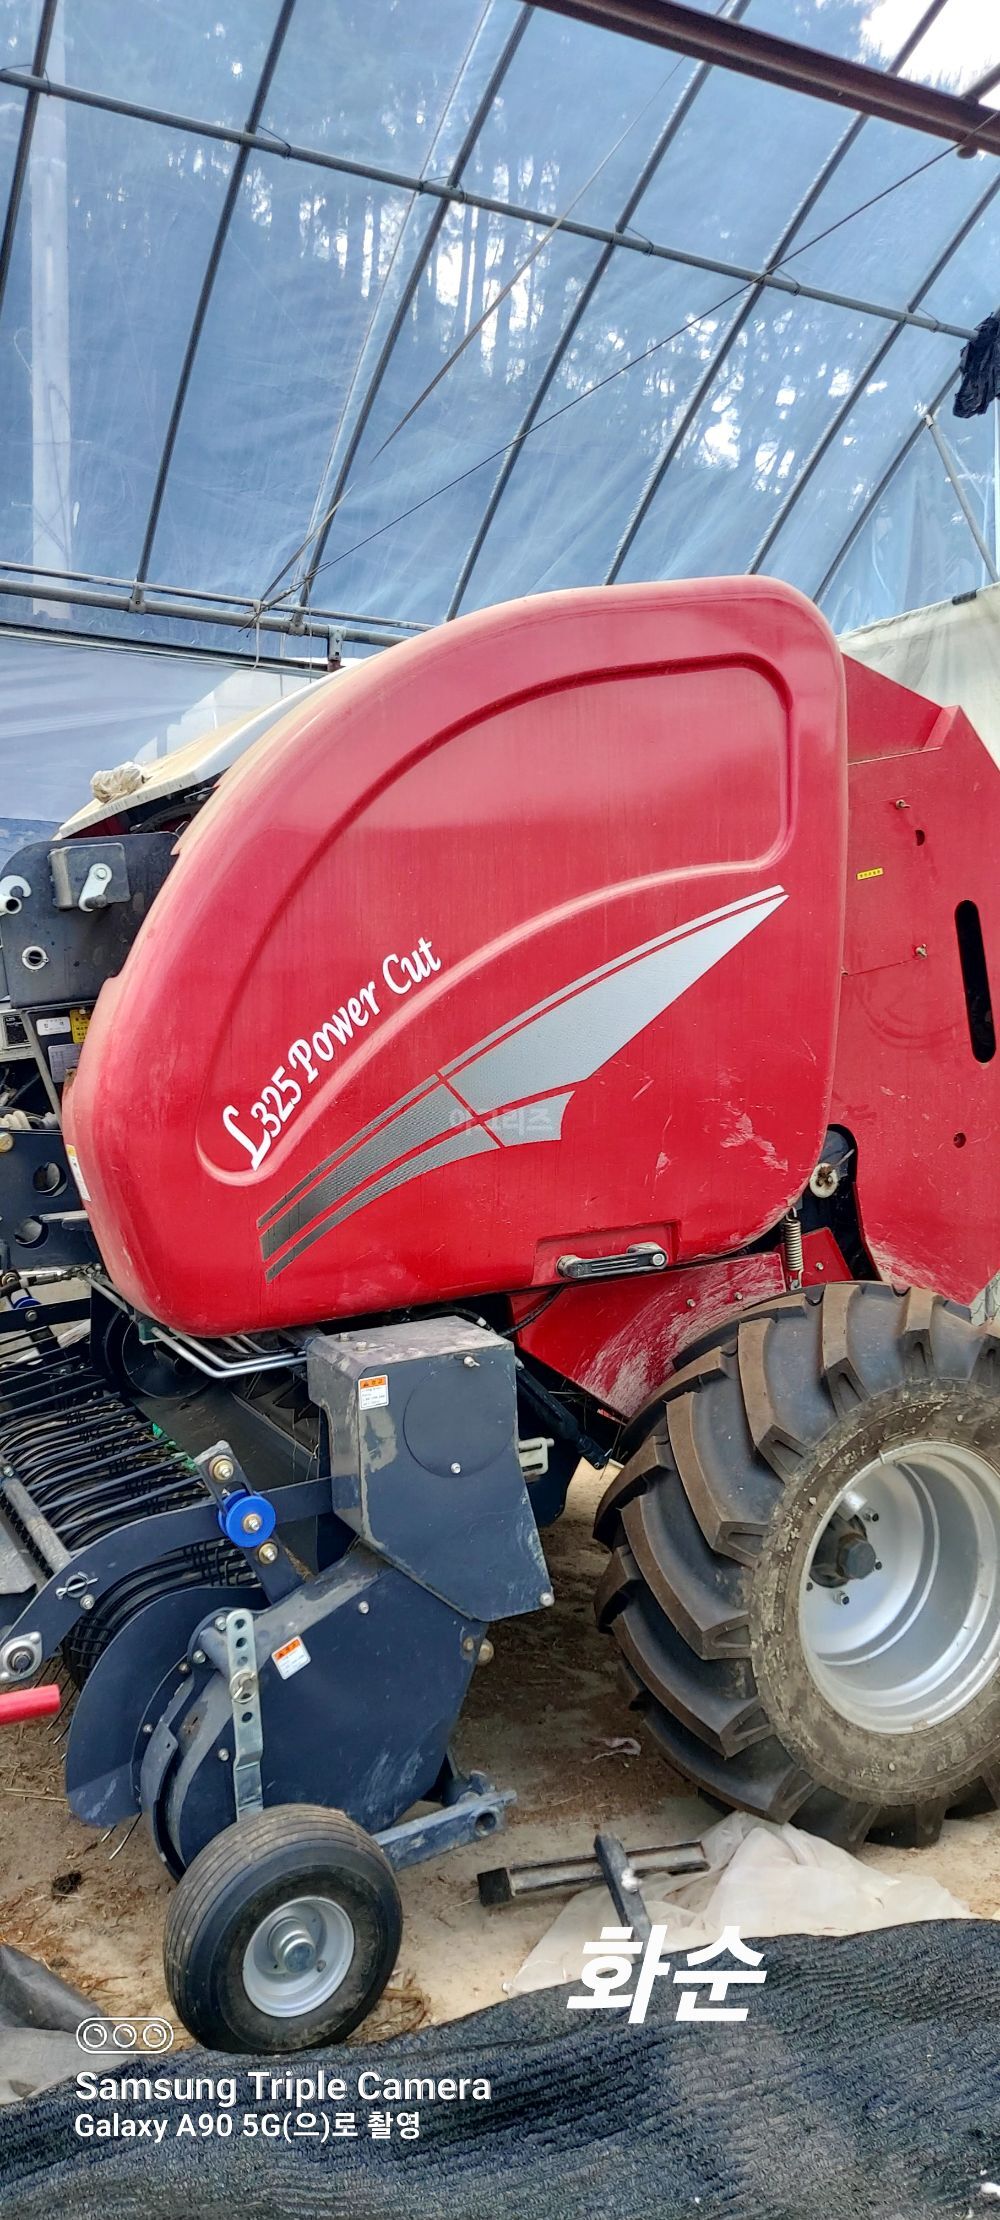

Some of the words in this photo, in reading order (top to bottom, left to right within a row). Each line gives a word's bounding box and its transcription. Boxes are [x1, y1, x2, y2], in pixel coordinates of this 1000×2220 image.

[222, 1065, 302, 1172] L325
[287, 980, 381, 1084] Power
[382, 936, 442, 995] Cut
